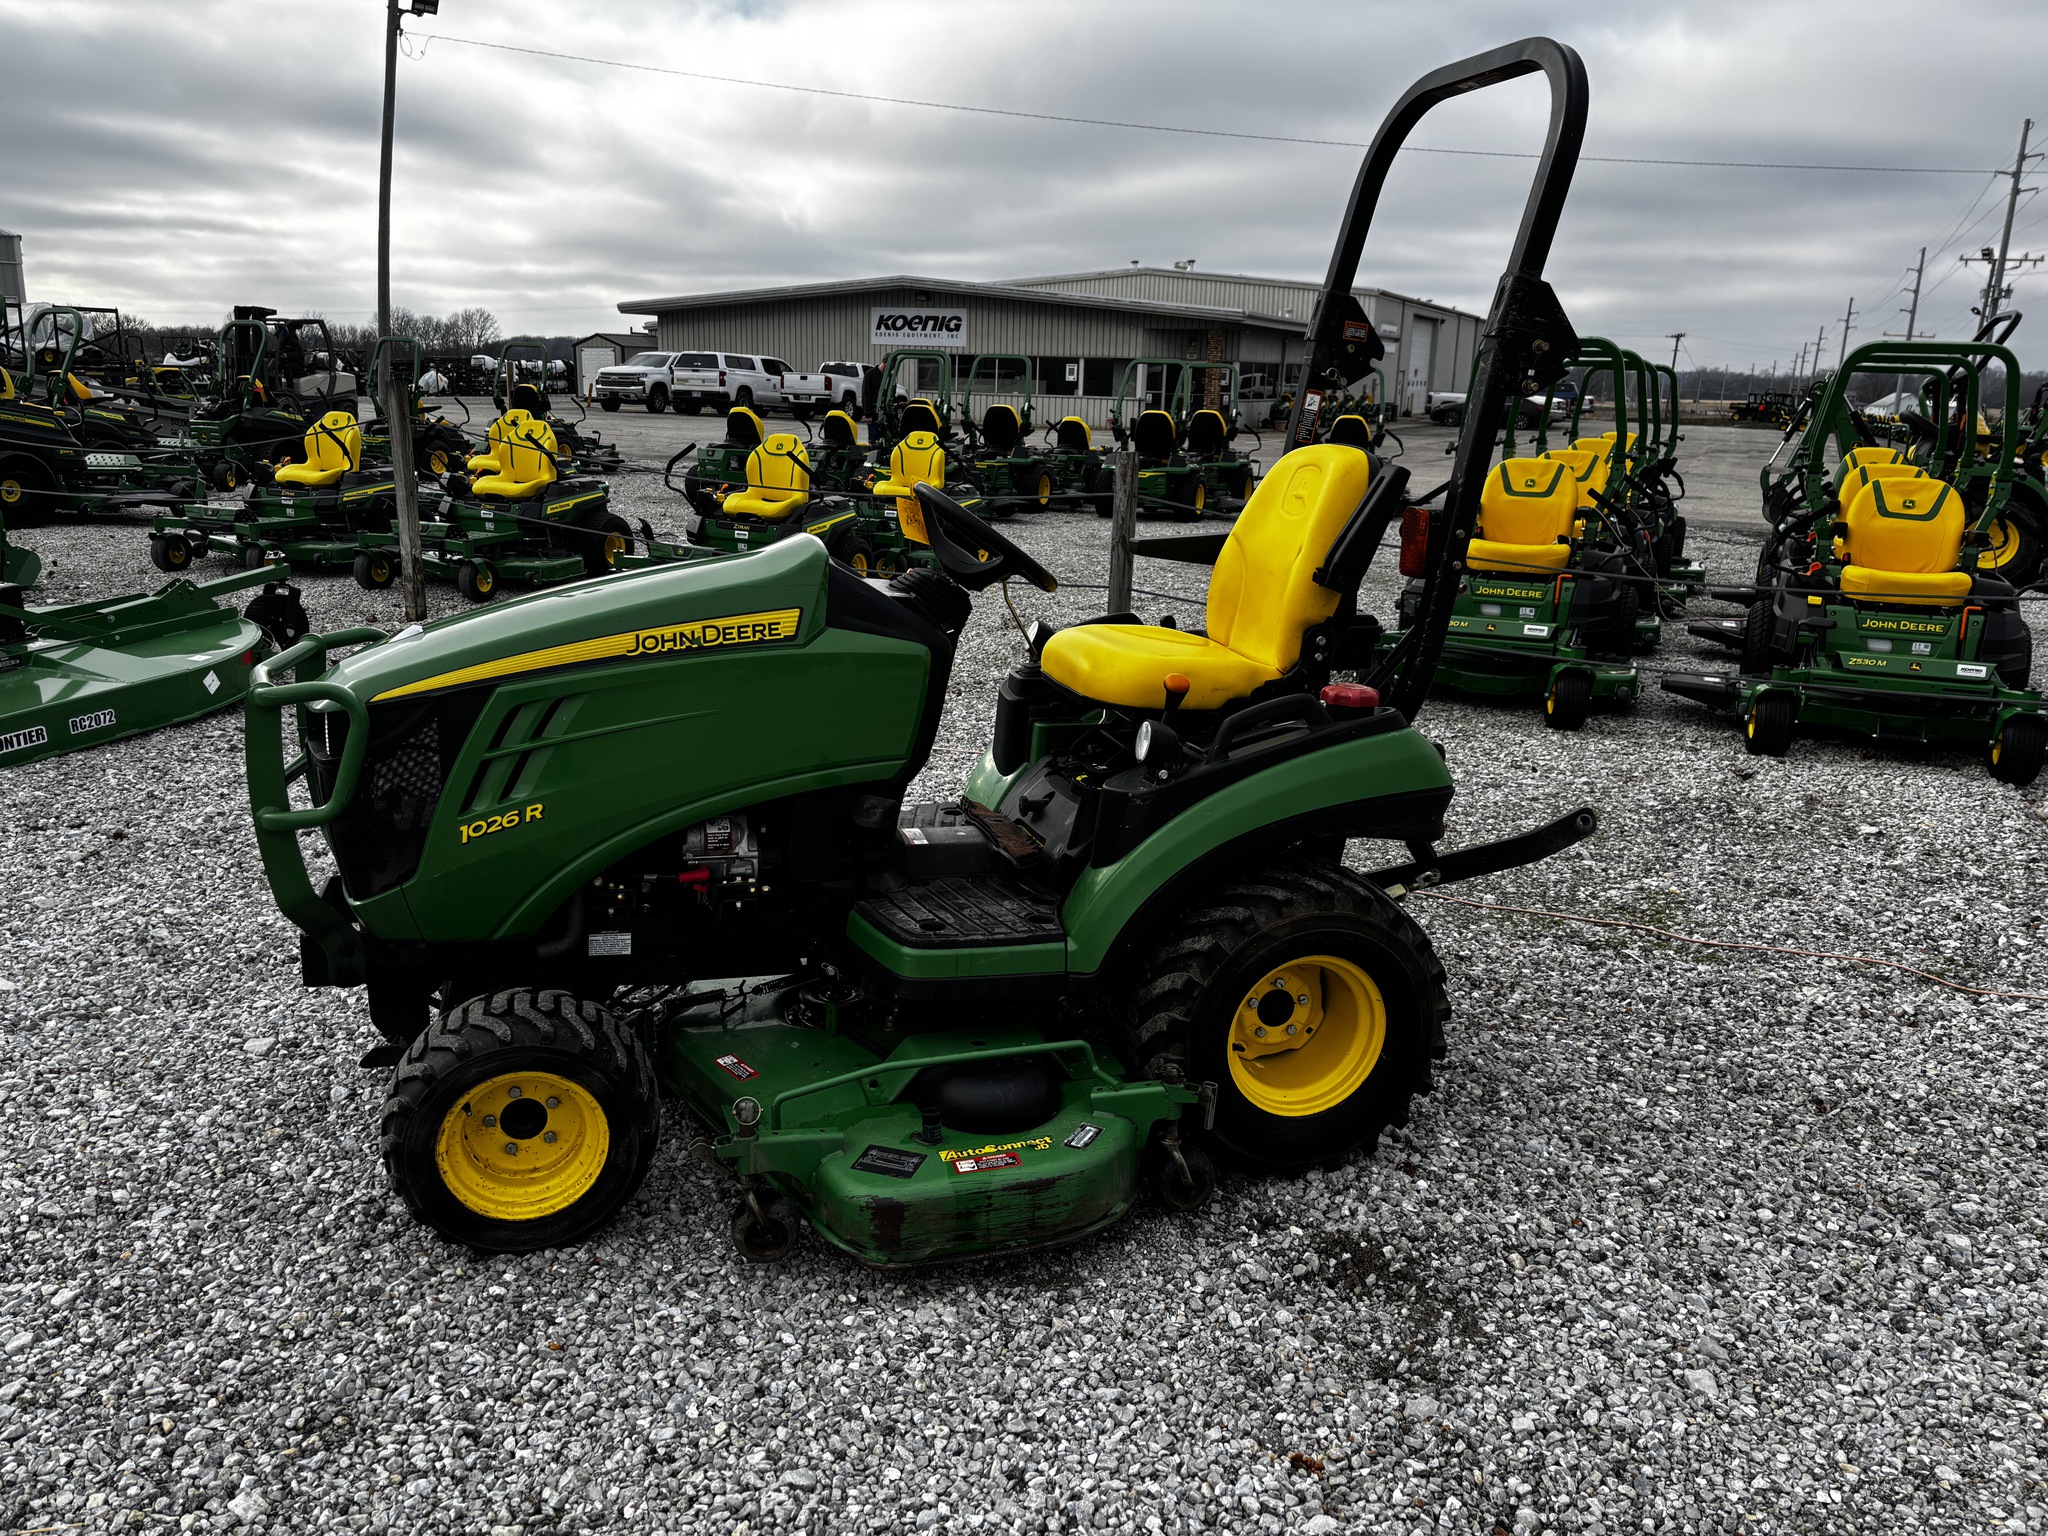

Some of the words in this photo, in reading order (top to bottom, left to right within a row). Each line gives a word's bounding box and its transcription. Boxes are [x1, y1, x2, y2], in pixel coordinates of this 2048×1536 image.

[1476, 586, 1504, 596] JOHN
[1507, 588, 1543, 598] DEERE
[1862, 619, 1897, 629] JOHN
[1900, 621, 1944, 632] DEERE
[626, 631, 698, 655] JOHN
[702, 622, 783, 645] DEERE
[1848, 657, 1876, 666] Z530
[70, 711, 115, 733] RC2072
[460, 810, 520, 844] 1026
[526, 803, 544, 823] R
[946, 1136, 1053, 1160] AutoConnect
